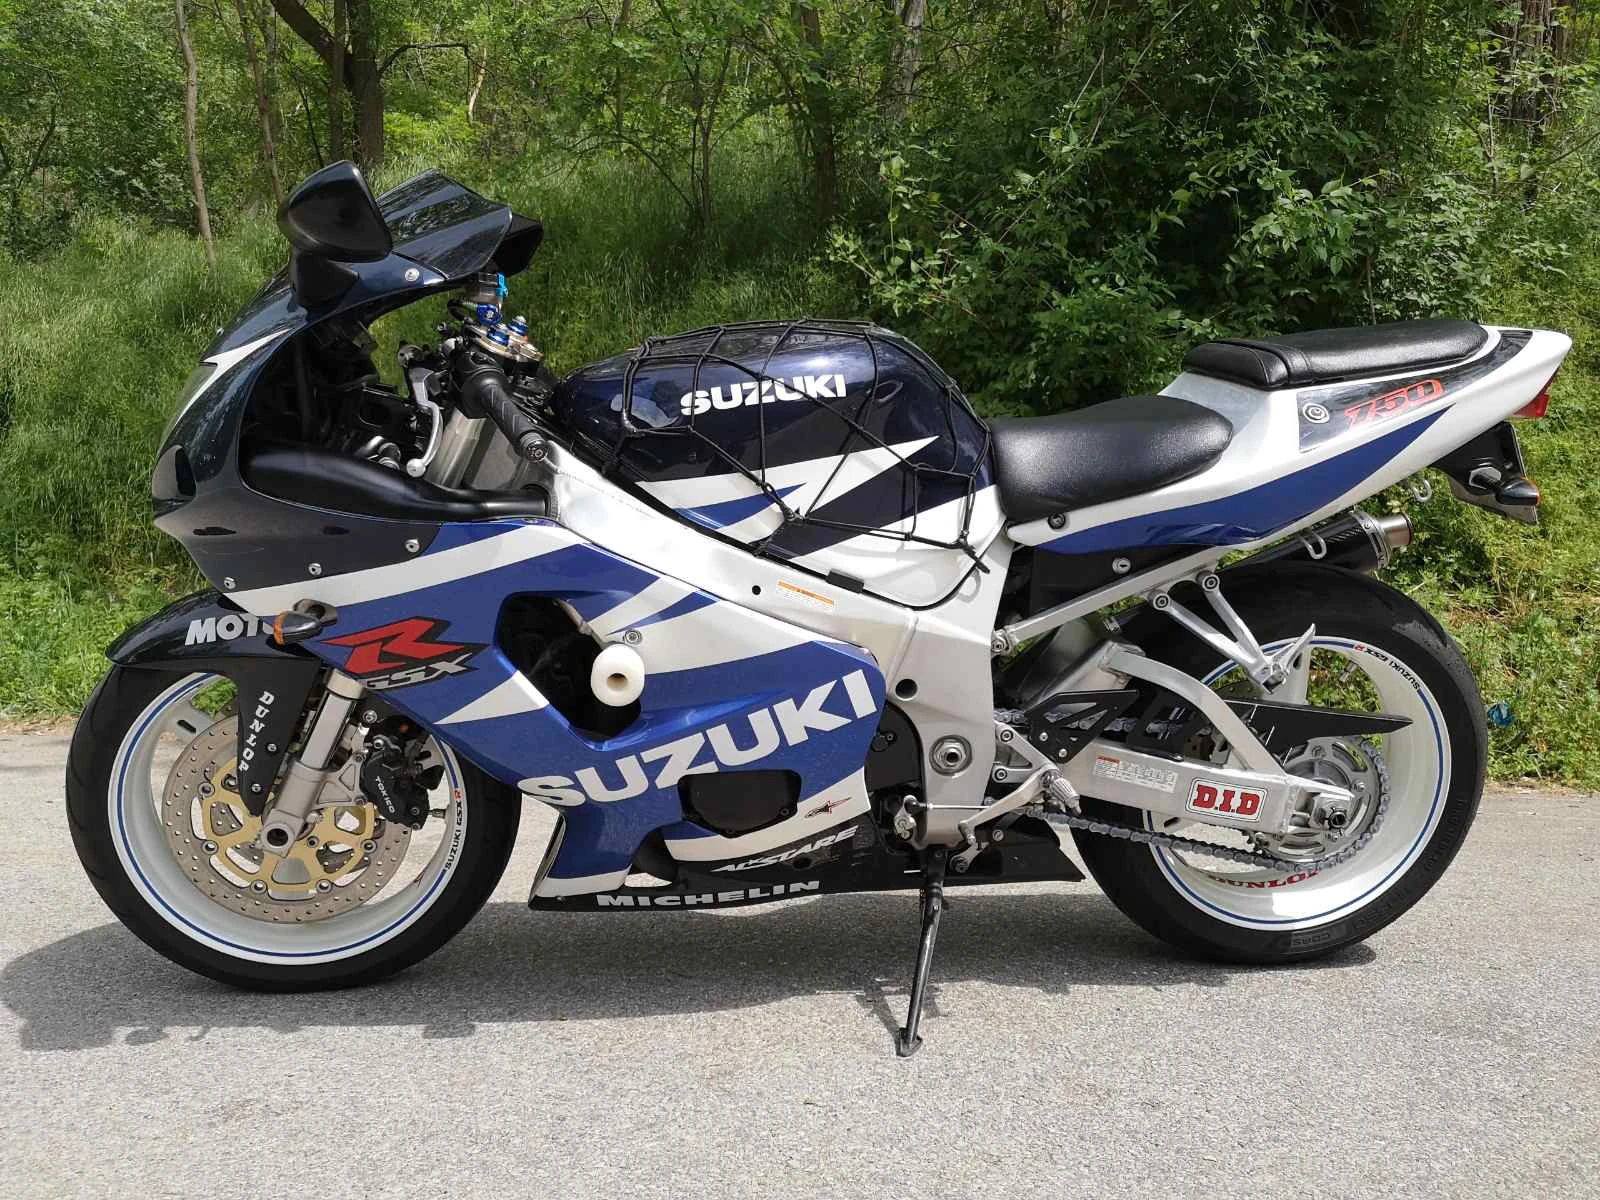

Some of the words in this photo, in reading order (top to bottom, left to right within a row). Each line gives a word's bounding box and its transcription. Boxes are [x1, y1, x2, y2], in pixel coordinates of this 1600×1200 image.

[680, 374, 847, 416] SUZUKI
[1344, 379, 1444, 431] 750
[359, 652, 473, 690] GSX
[1388, 661, 1420, 690] SUZUKI
[239, 690, 275, 772] DUNLOP
[517, 669, 878, 807] SUZUKI
[375, 775, 396, 814] TOKICO
[1193, 784, 1260, 816] D.I.D
[445, 829, 462, 869] SUZUKI
[596, 880, 820, 907] MICHELIN
